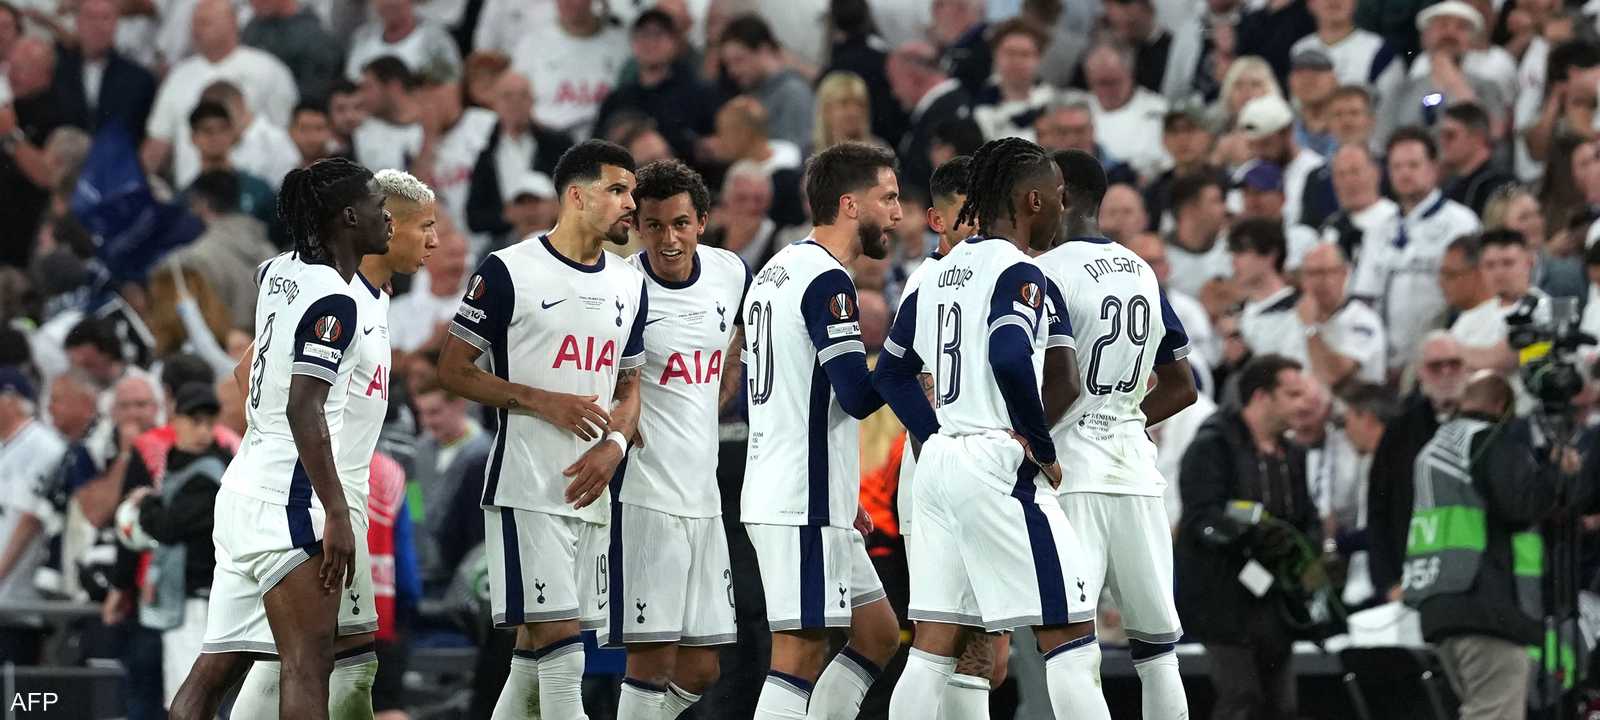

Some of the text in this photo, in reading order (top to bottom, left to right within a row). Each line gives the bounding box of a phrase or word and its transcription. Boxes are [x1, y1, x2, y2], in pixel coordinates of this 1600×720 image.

[552, 334, 614, 374] AIA
[936, 301, 961, 409] 13
[1086, 294, 1150, 395] 29
[366, 364, 387, 400] AI
[659, 350, 721, 385] AIA
[596, 554, 607, 595] 19
